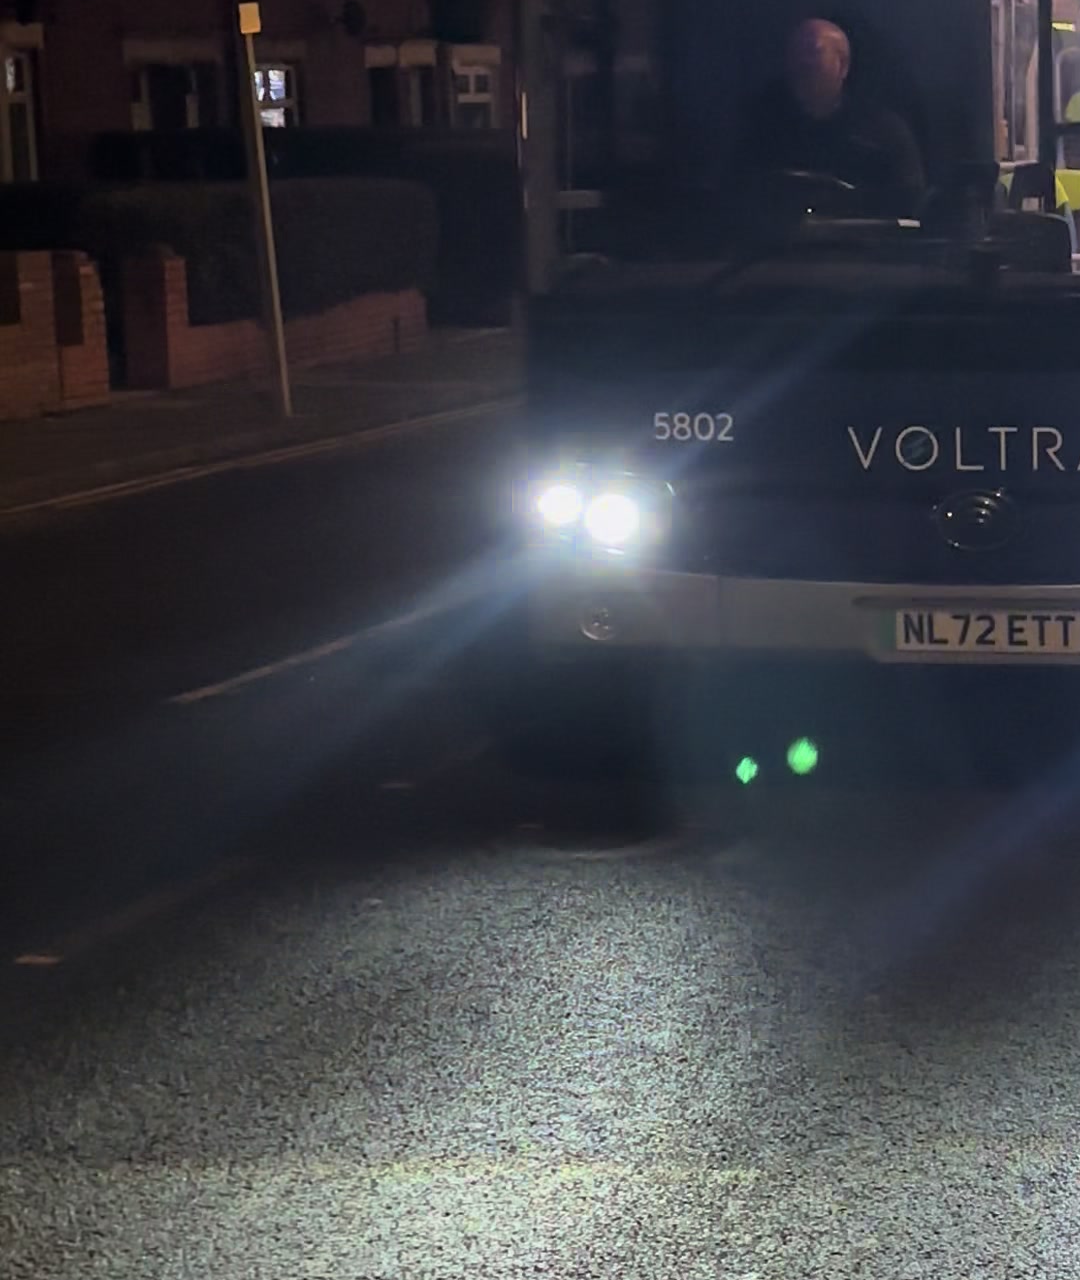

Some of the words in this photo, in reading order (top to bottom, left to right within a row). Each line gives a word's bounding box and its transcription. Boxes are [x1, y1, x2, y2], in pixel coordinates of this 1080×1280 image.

[653, 412, 734, 442] 5802
[902, 612, 997, 647] NL72
[1007, 614, 1077, 647] ETT
